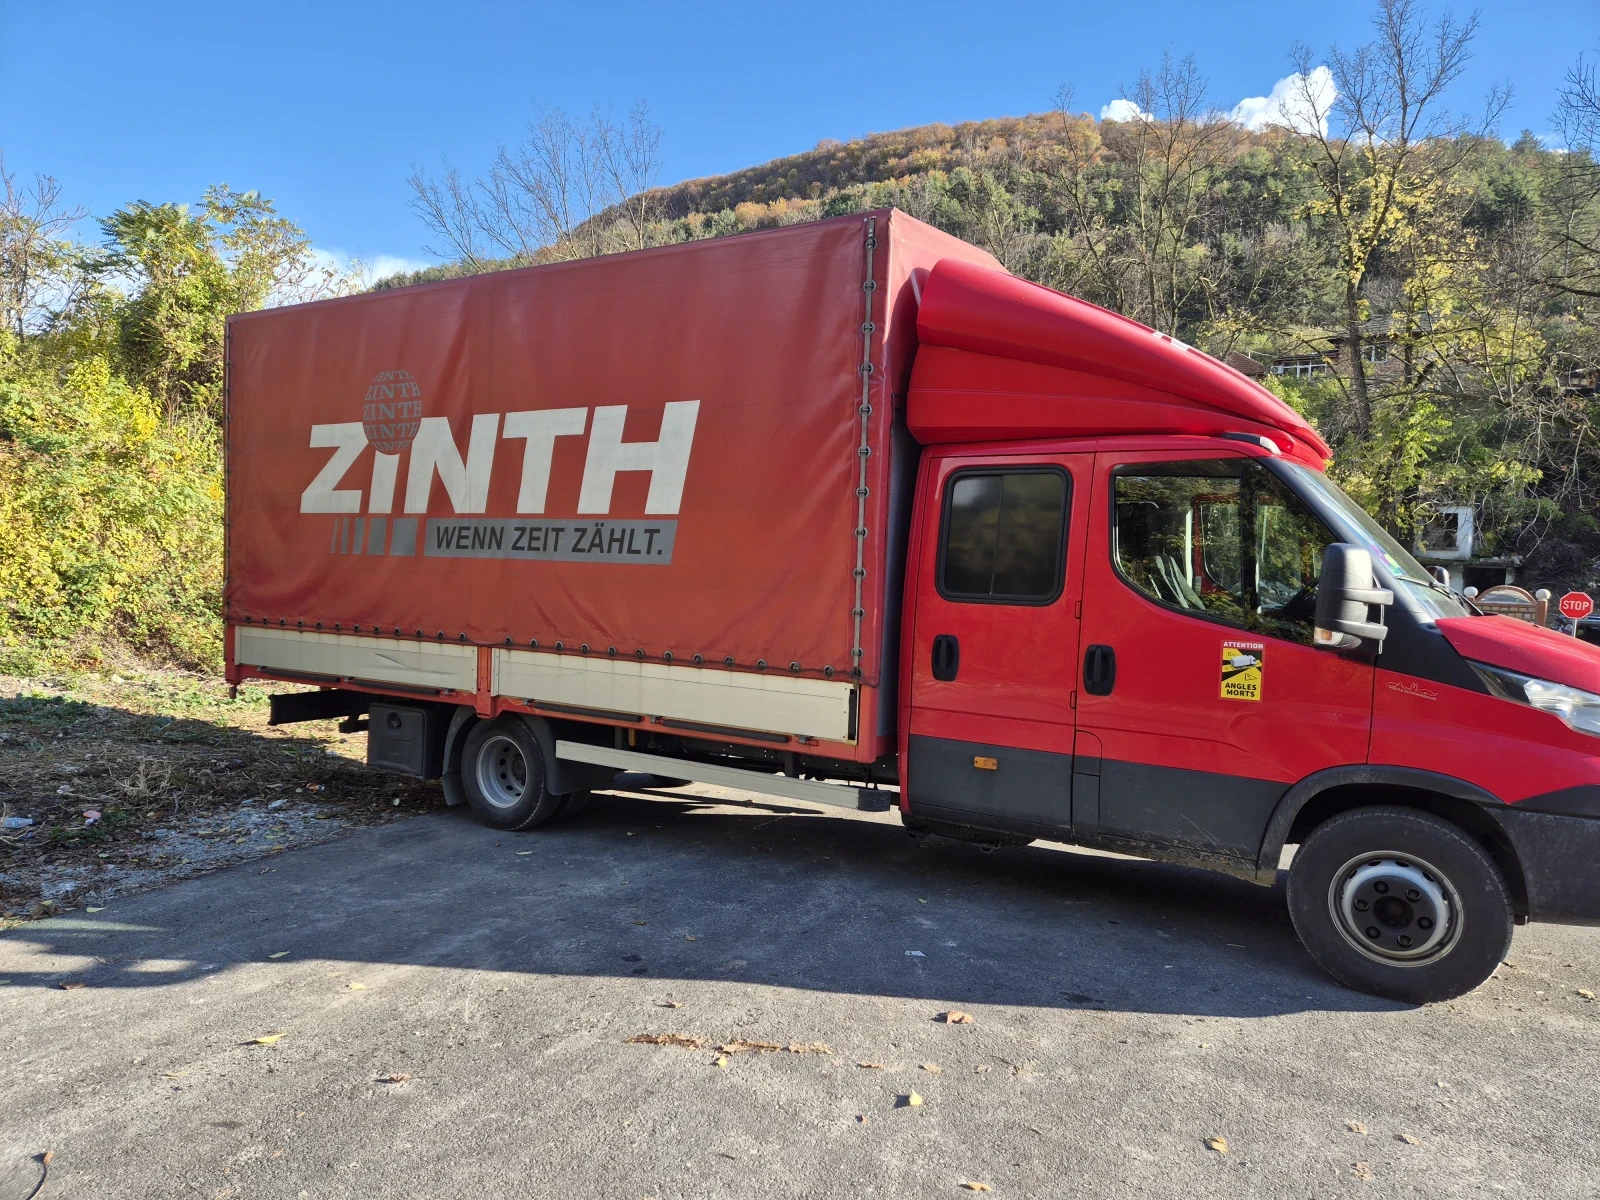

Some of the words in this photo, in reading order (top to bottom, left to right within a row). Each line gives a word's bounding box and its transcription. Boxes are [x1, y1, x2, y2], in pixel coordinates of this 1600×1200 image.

[364, 382, 421, 400] ZINTH
[363, 400, 422, 421] ZINTH
[364, 422, 420, 439] ZINTH
[436, 526, 505, 550] WENN
[511, 527, 566, 552] ZEIT
[571, 522, 663, 556] ZÄHLT.
[1562, 600, 1590, 611] STOP
[1223, 641, 1264, 649] ATTENTION
[1225, 682, 1257, 691] ANGLES
[1226, 689, 1255, 697] MORTS
